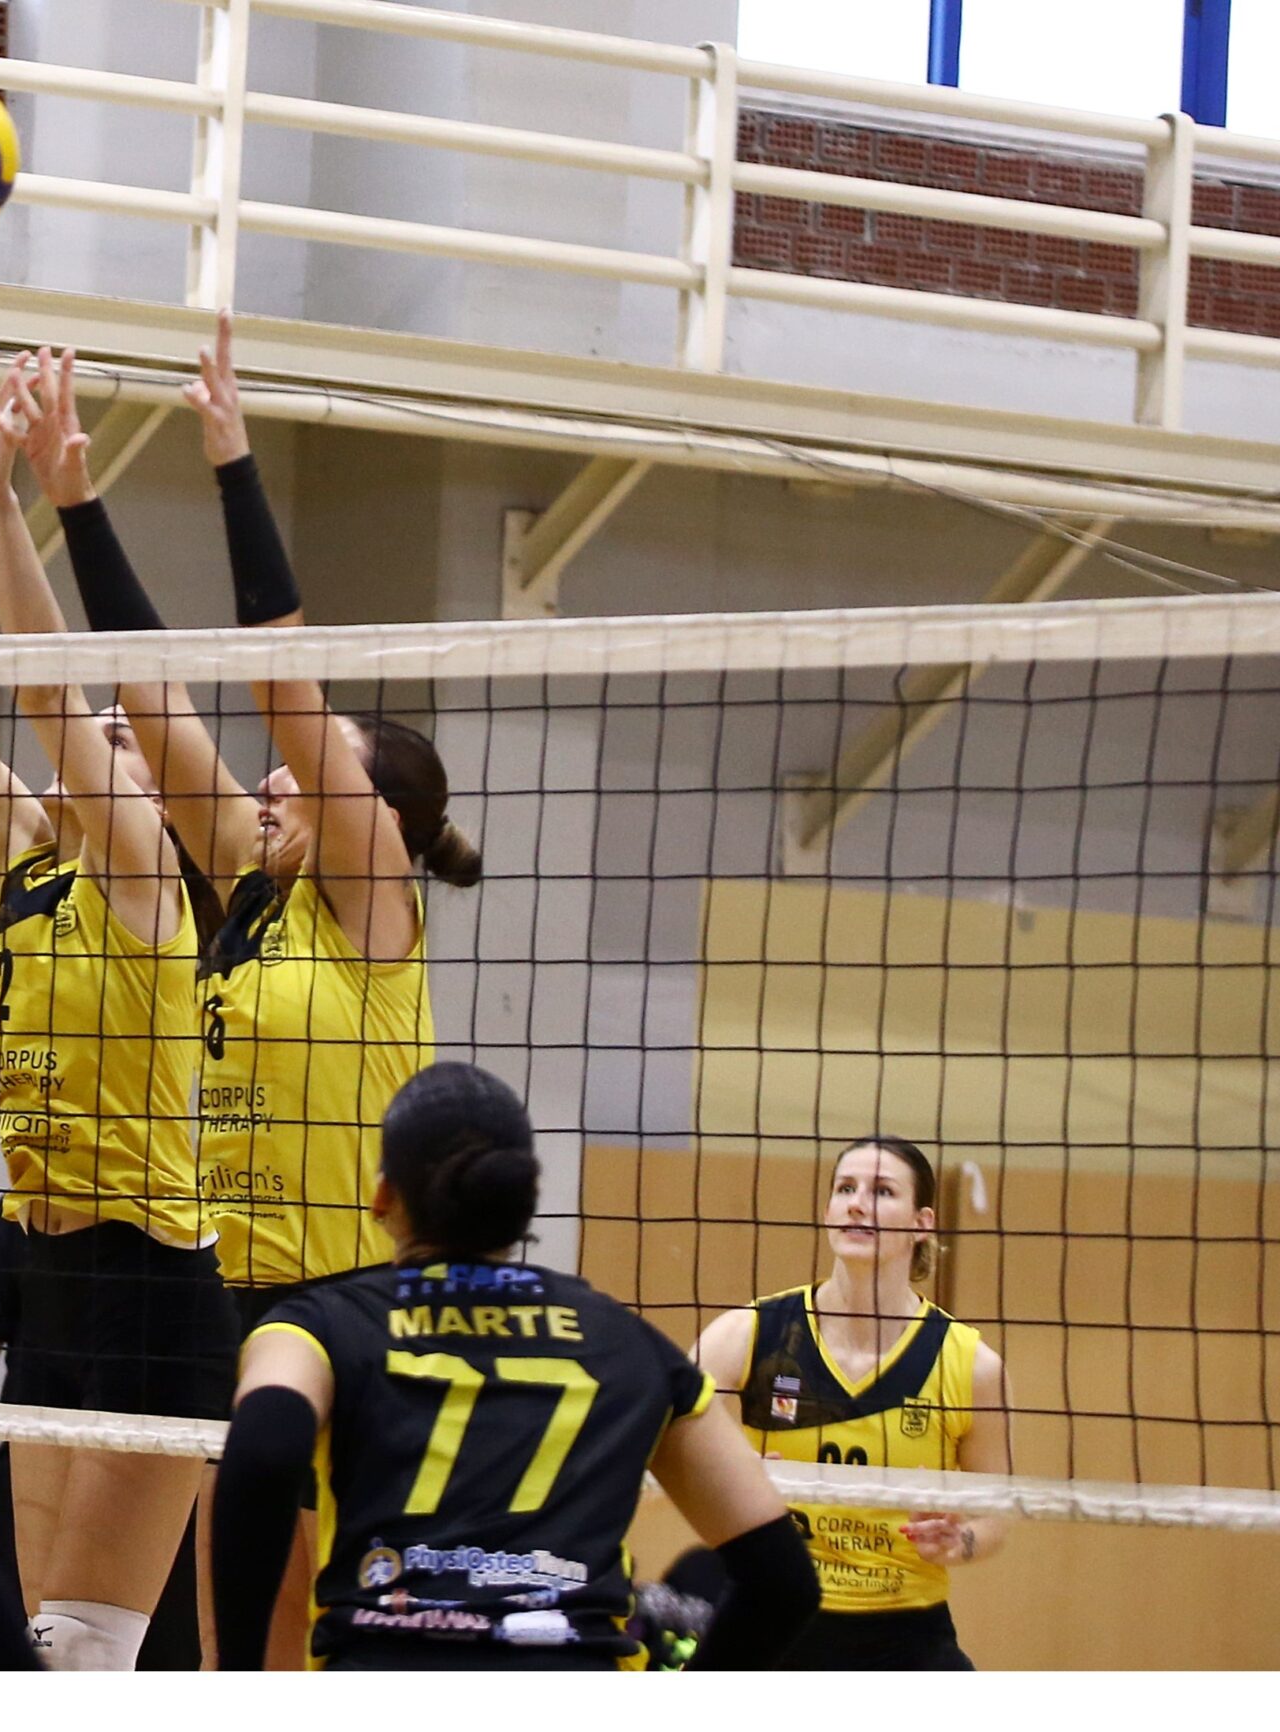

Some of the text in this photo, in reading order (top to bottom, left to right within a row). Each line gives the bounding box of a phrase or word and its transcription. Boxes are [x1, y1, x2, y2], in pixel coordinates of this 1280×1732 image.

[0, 1050, 58, 1071] ORPUS
[200, 1087, 266, 1109] CORPUS
[388, 1305, 584, 1341] MARTE
[386, 1349, 600, 1515] 77
[825, 1535, 895, 1553] HERAPY
